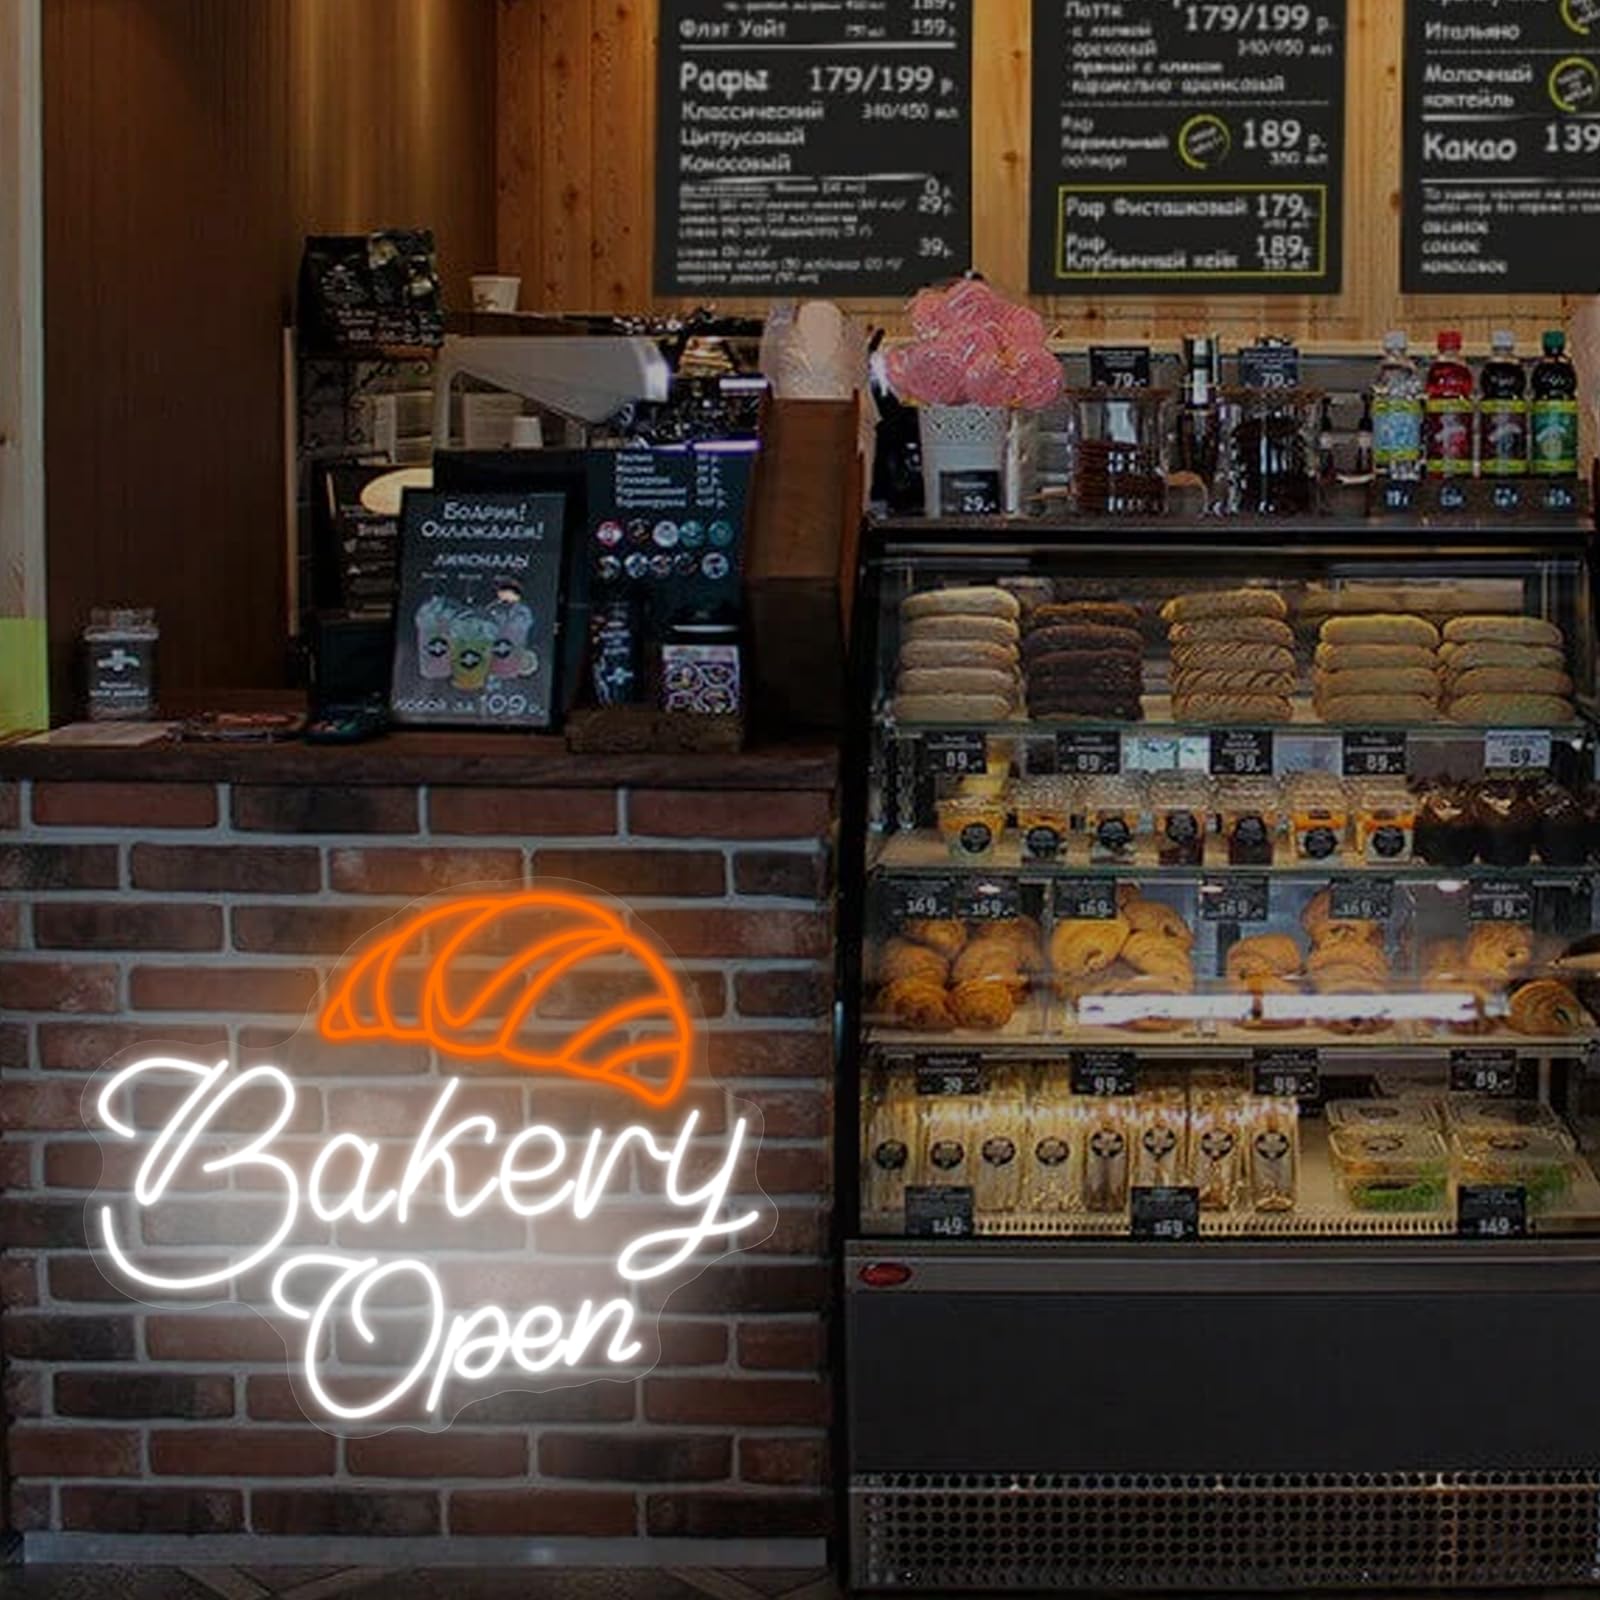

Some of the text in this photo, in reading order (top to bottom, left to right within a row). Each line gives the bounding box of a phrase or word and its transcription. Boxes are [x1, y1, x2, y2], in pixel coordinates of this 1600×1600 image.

[738, 19, 787, 37] Уайт
[1186, 5, 1309, 31] 179/199
[1425, 21, 1521, 40] Итальяно
[679, 61, 768, 100] Рафы
[810, 65, 935, 93] 179/199
[1424, 63, 1534, 82] Молочный
[681, 101, 824, 120] Классический
[680, 127, 805, 149] Цитрусовый
[1242, 119, 1302, 148] 189
[1423, 121, 1600, 161] Какао 139
[680, 153, 791, 172] Кокосовый
[1066, 196, 1105, 221] Раф
[1113, 197, 1247, 217] Фисташковый
[97, 1058, 760, 1289] Bakery
[272, 1254, 642, 1420] Open
